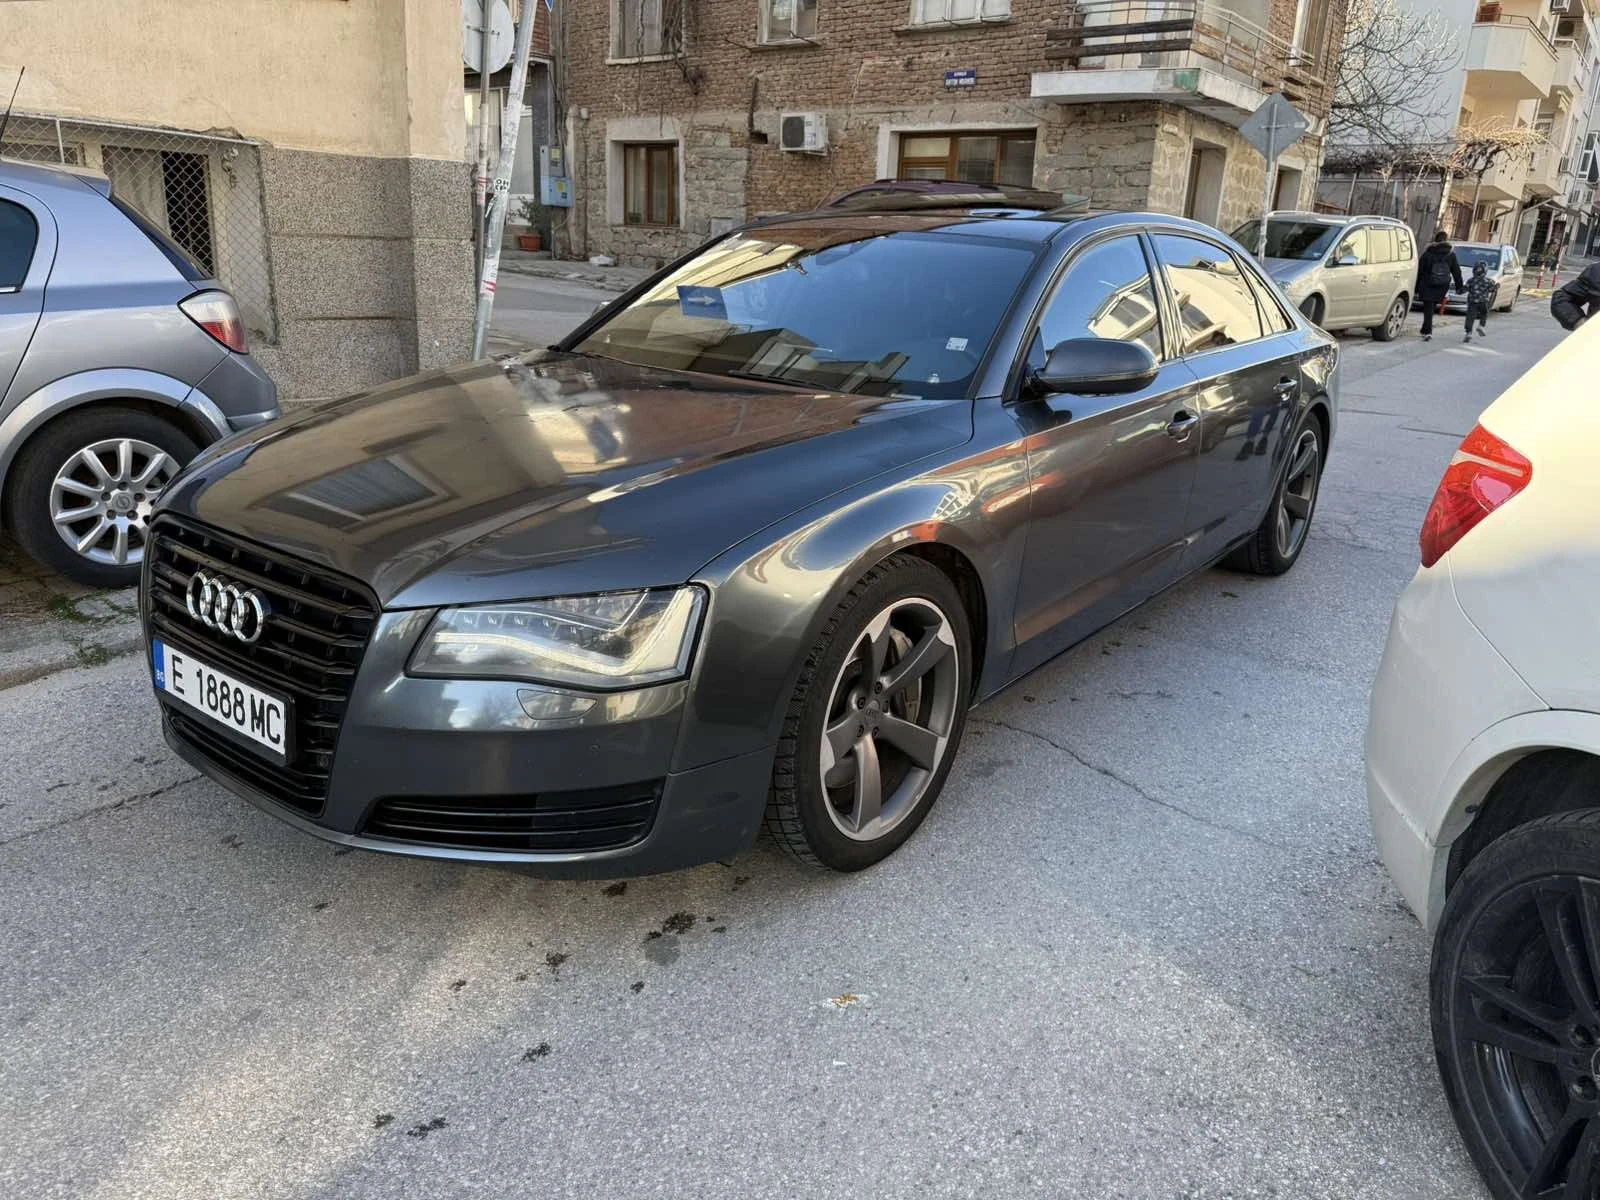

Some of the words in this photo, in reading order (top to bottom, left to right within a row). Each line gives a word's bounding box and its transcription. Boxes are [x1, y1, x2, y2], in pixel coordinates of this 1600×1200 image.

[172, 654, 184, 695] E
[196, 668, 245, 726] 1888
[251, 694, 281, 744] MC
